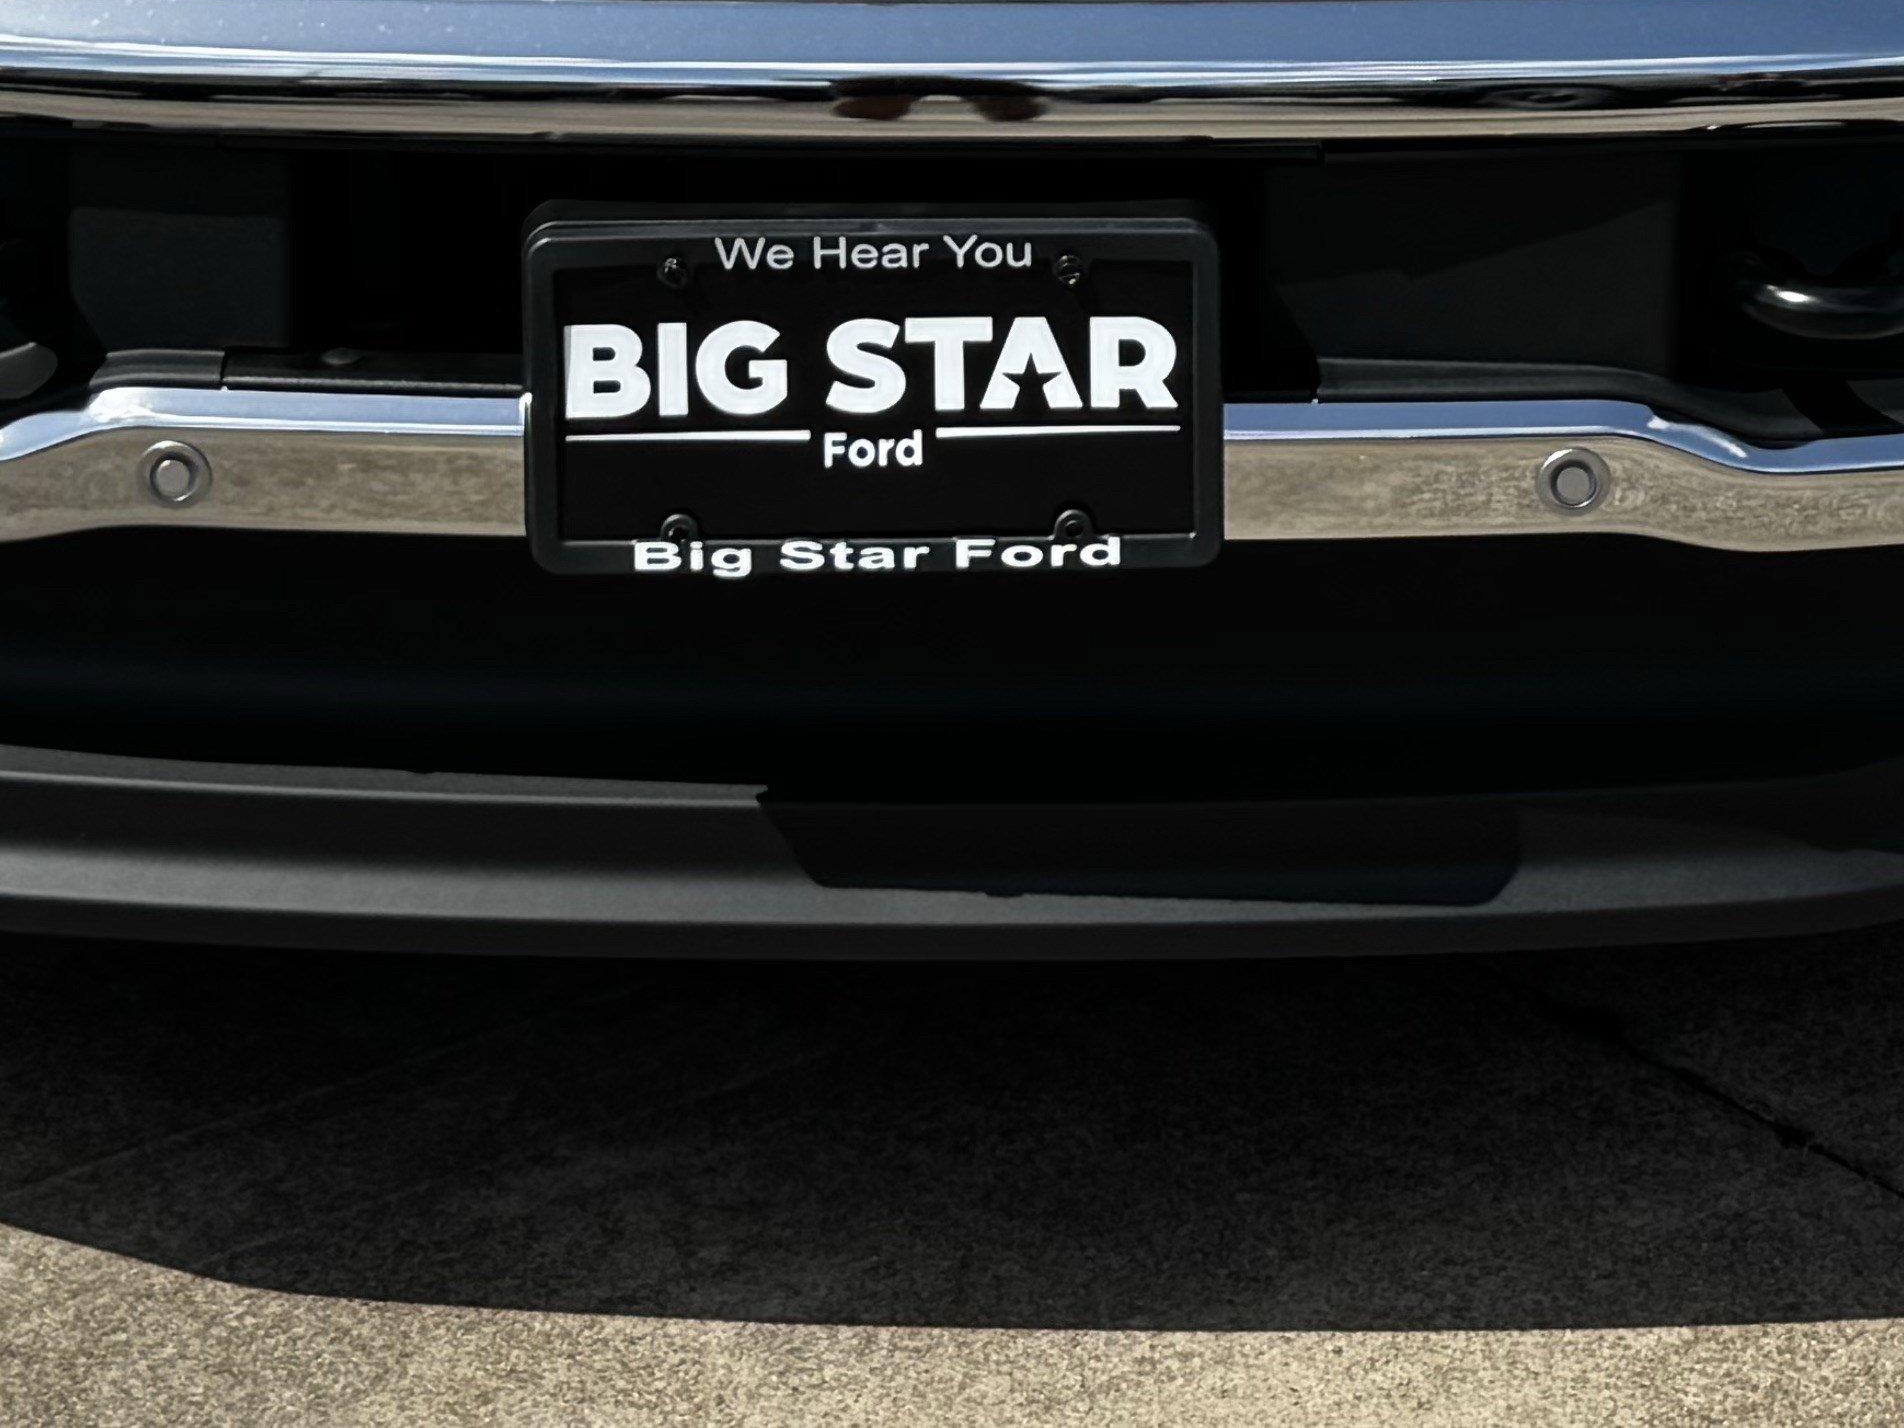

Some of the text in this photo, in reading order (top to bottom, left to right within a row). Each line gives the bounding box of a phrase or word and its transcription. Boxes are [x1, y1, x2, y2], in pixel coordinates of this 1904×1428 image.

[714, 233, 1033, 270] We Hear You
[563, 315, 1179, 421] BIG STAR
[823, 428, 924, 469] Ford
[633, 533, 1122, 579] Big Star Ford
